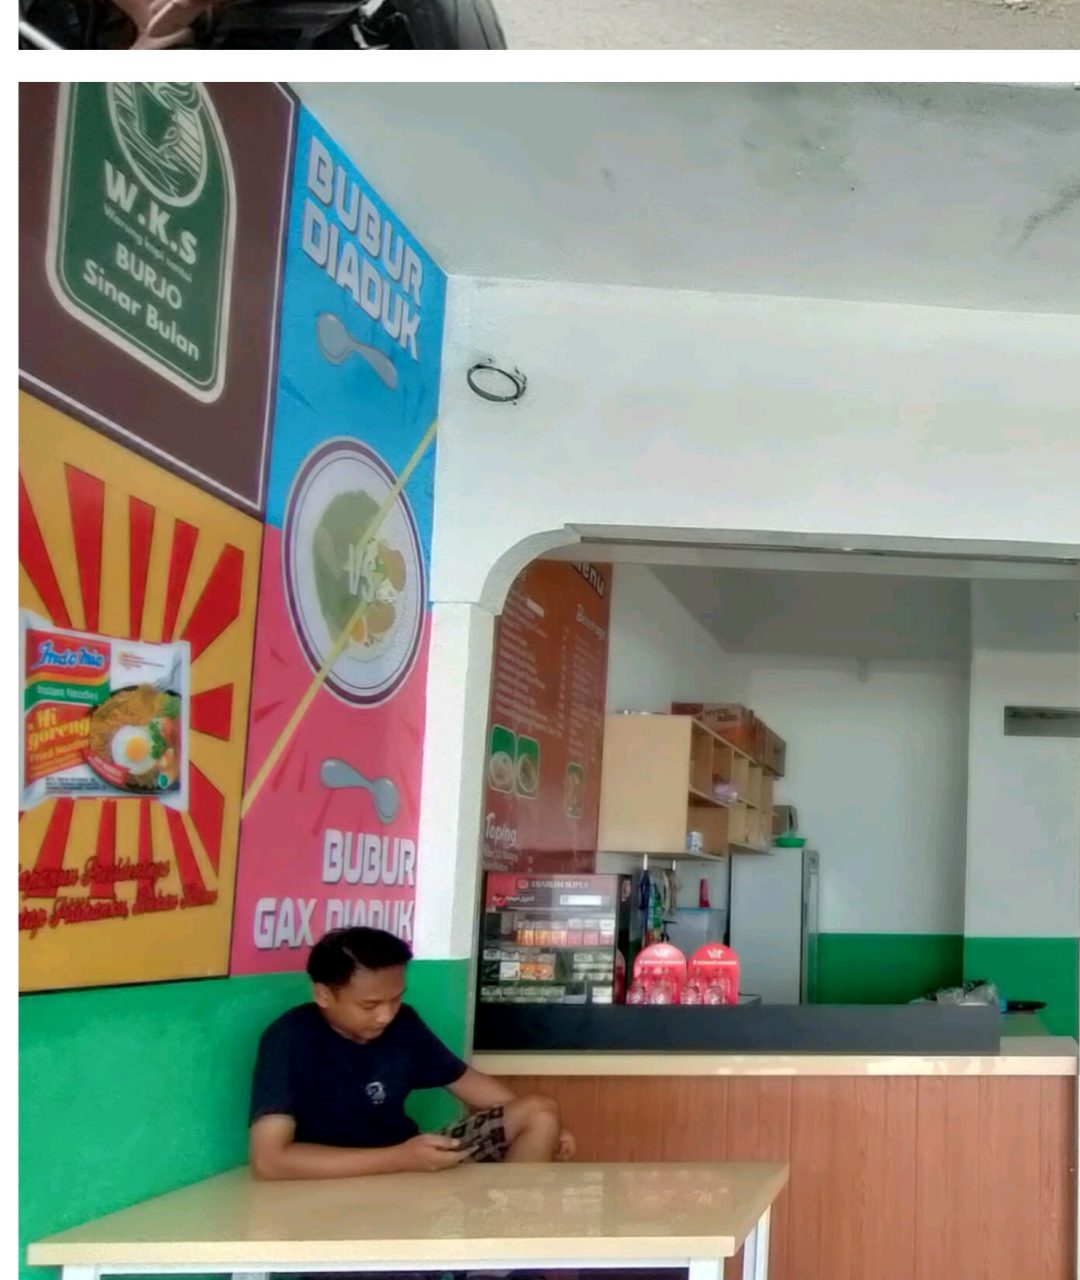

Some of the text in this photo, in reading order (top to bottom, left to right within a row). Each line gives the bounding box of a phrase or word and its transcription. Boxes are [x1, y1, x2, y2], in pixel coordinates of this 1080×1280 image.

[104, 158, 198, 265] W.K.S
[306, 134, 424, 311] BUBUR
[82, 258, 200, 361] Sinar Bulan
[115, 241, 183, 310] BURJO
[301, 198, 421, 362] DIADUK
[574, 560, 604, 597] enu
[322, 828, 416, 886] BUBUR
[253, 896, 318, 950] GAX
